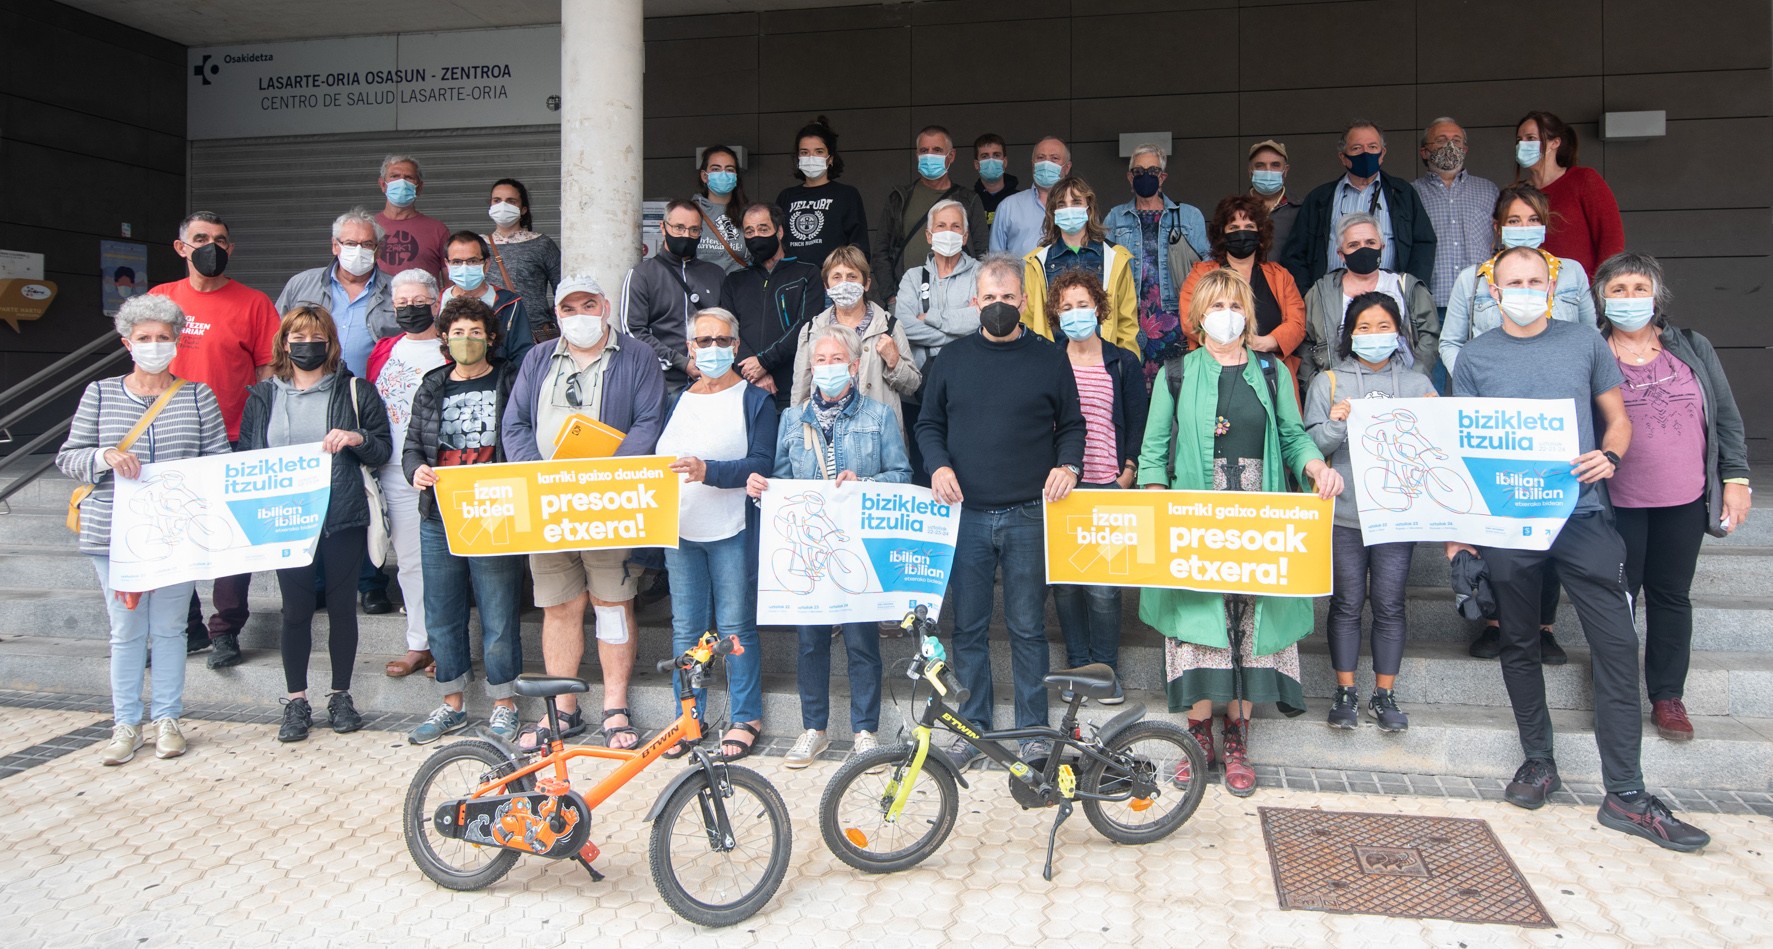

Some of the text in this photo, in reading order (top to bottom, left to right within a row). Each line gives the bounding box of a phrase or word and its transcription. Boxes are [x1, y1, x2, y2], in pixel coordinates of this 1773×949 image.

[224, 53, 274, 64] Osakidetza
[258, 71, 361, 91] LASARTE-ORIA
[365, 68, 426, 85] OSASUN
[441, 64, 512, 81] ZENTROA
[261, 85, 508, 111] CENTRO DE SALUD LASARTE-ORIA
[1458, 409, 1564, 432] bizikleta
[1459, 430, 1533, 451] itzulia
[225, 456, 320, 479] bizikleta
[538, 467, 664, 484] larriki gaixo dauden
[224, 474, 293, 494] itzulia
[1496, 472, 1544, 488] ibilian
[474, 483, 512, 500] izan
[1514, 486, 1563, 500] ibilian
[258, 503, 302, 519] ibilian
[462, 501, 515, 519] bidea
[541, 483, 658, 520] presoak
[861, 493, 950, 518] bizikleta
[1168, 502, 1319, 520] larriki gaixo dauden
[275, 513, 319, 528] ibilian
[861, 512, 923, 533] itzulia
[1092, 508, 1137, 527] izan
[543, 513, 646, 543] etxera!
[1077, 526, 1138, 545] bidea
[1169, 523, 1308, 553] presoak
[889, 551, 930, 565] ibilian
[904, 563, 944, 580] ibilian
[1169, 554, 1288, 585] etxera!
